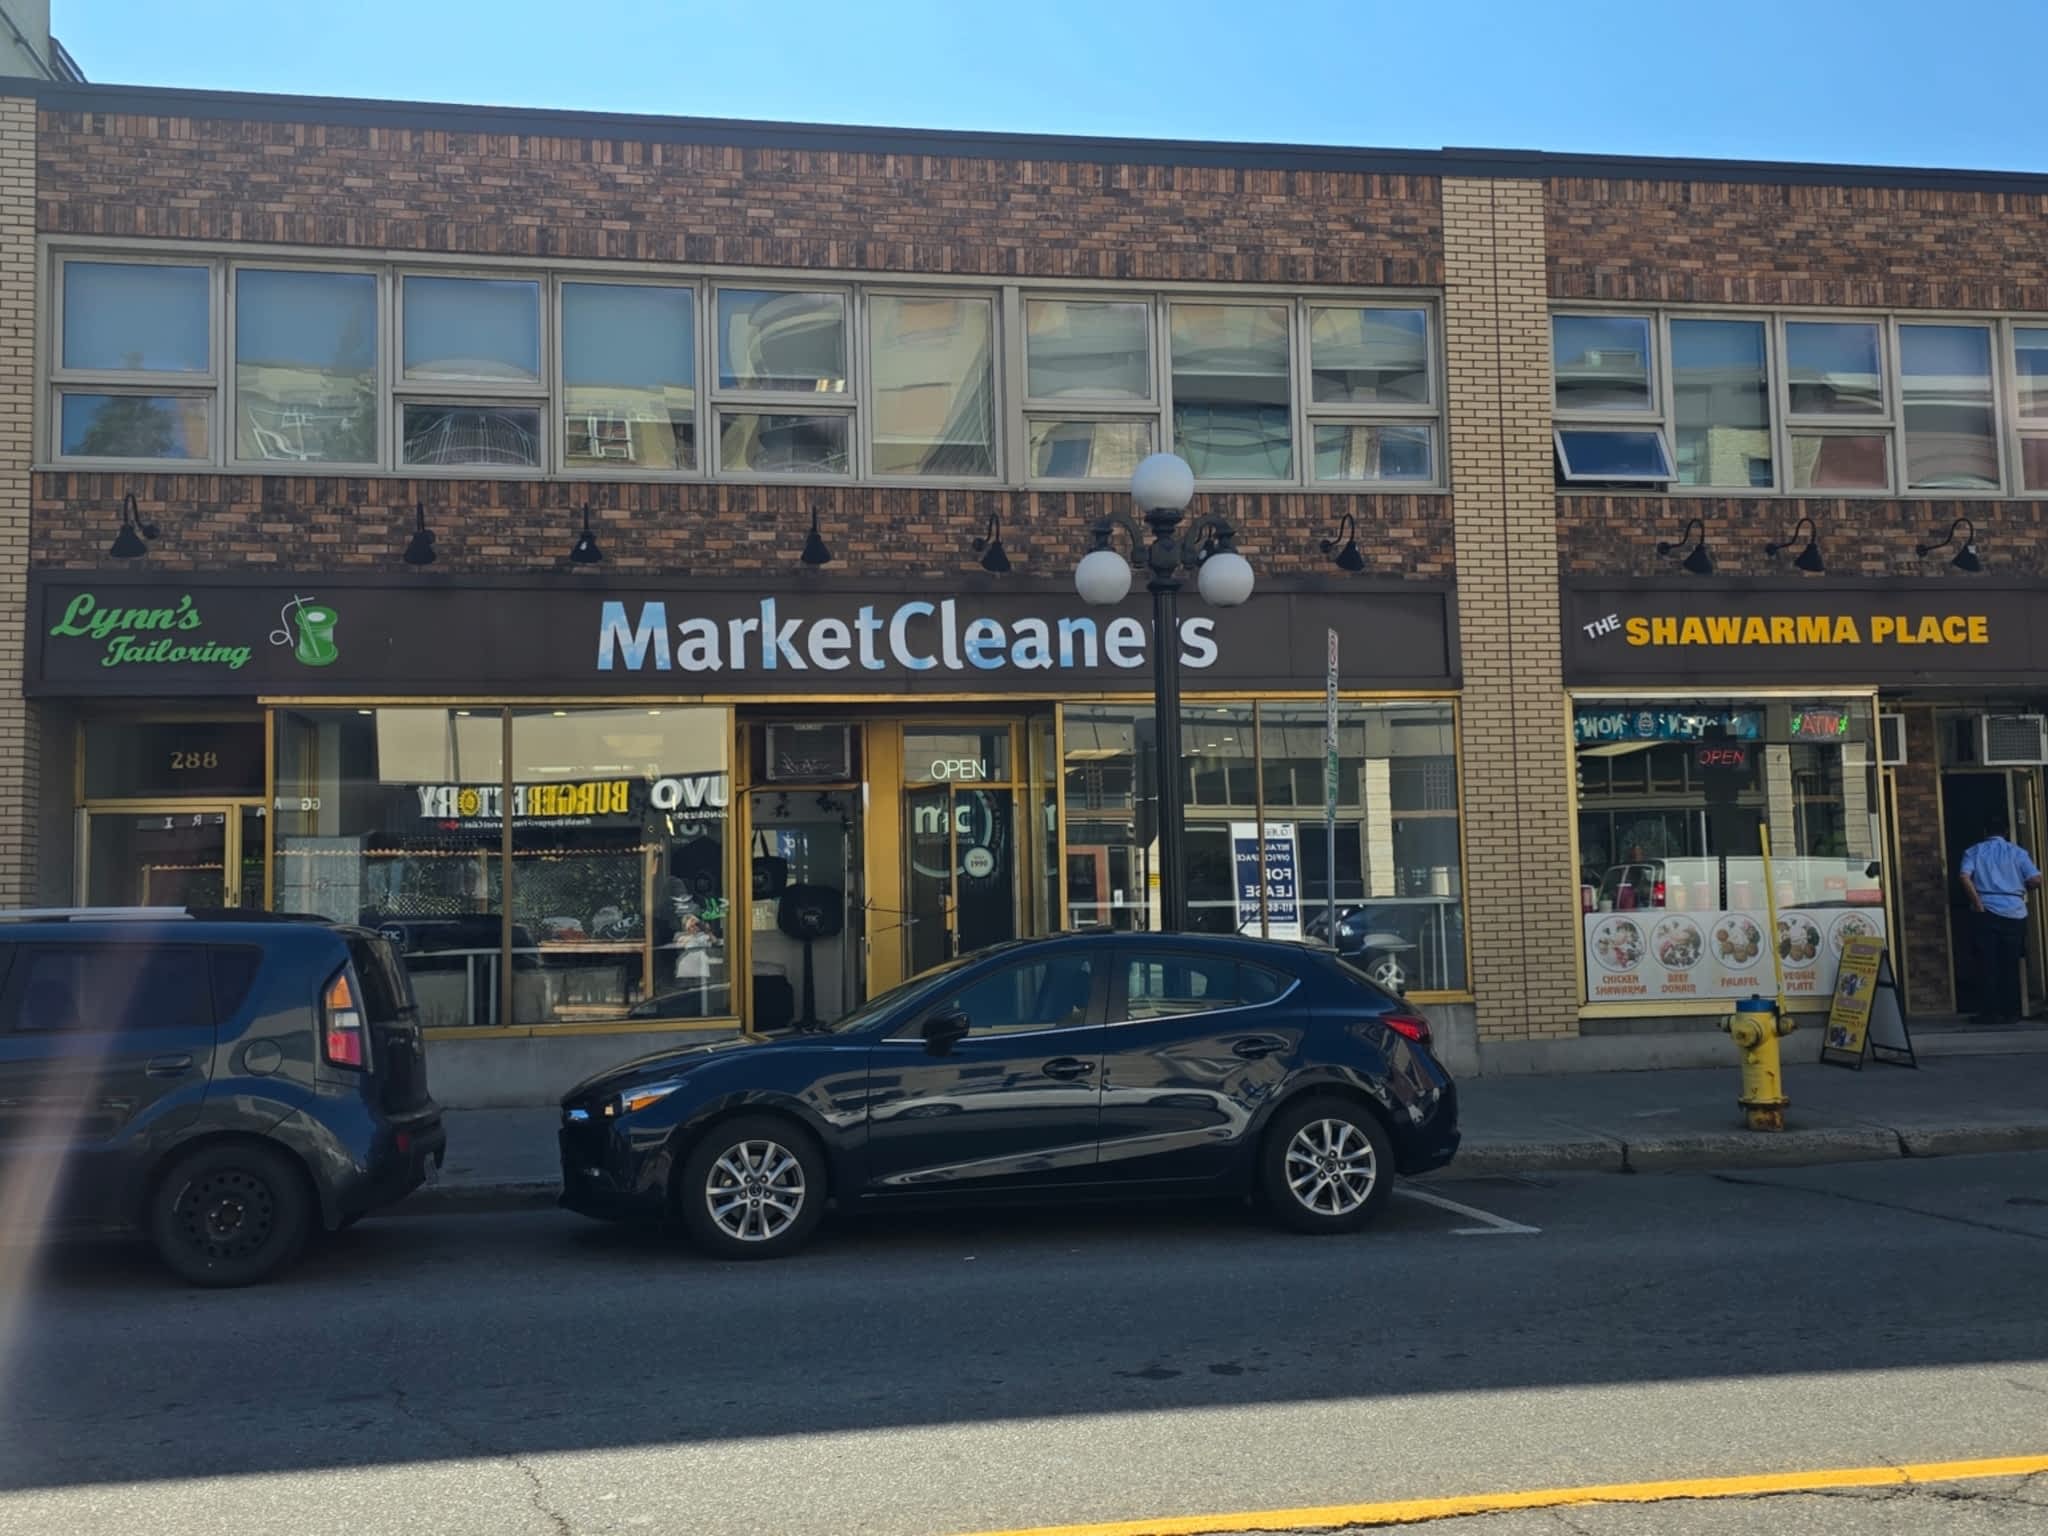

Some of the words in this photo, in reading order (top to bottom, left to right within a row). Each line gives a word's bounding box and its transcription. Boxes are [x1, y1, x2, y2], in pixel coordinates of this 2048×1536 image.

[50, 593, 202, 639] Lynn's
[597, 597, 1218, 670] MarketCleanes
[1583, 613, 1622, 640] THE
[1625, 616, 1860, 646] SHAWARMA
[1871, 616, 1989, 644] PLACE
[101, 635, 251, 669] Tailoring
[1801, 712, 1840, 736] ATM
[170, 751, 218, 770] 288
[1700, 750, 1745, 765] OPEN
[931, 759, 986, 780] OPEN
[1720, 976, 1760, 987] FALAFEL
[1786, 981, 1815, 992] PLATE
